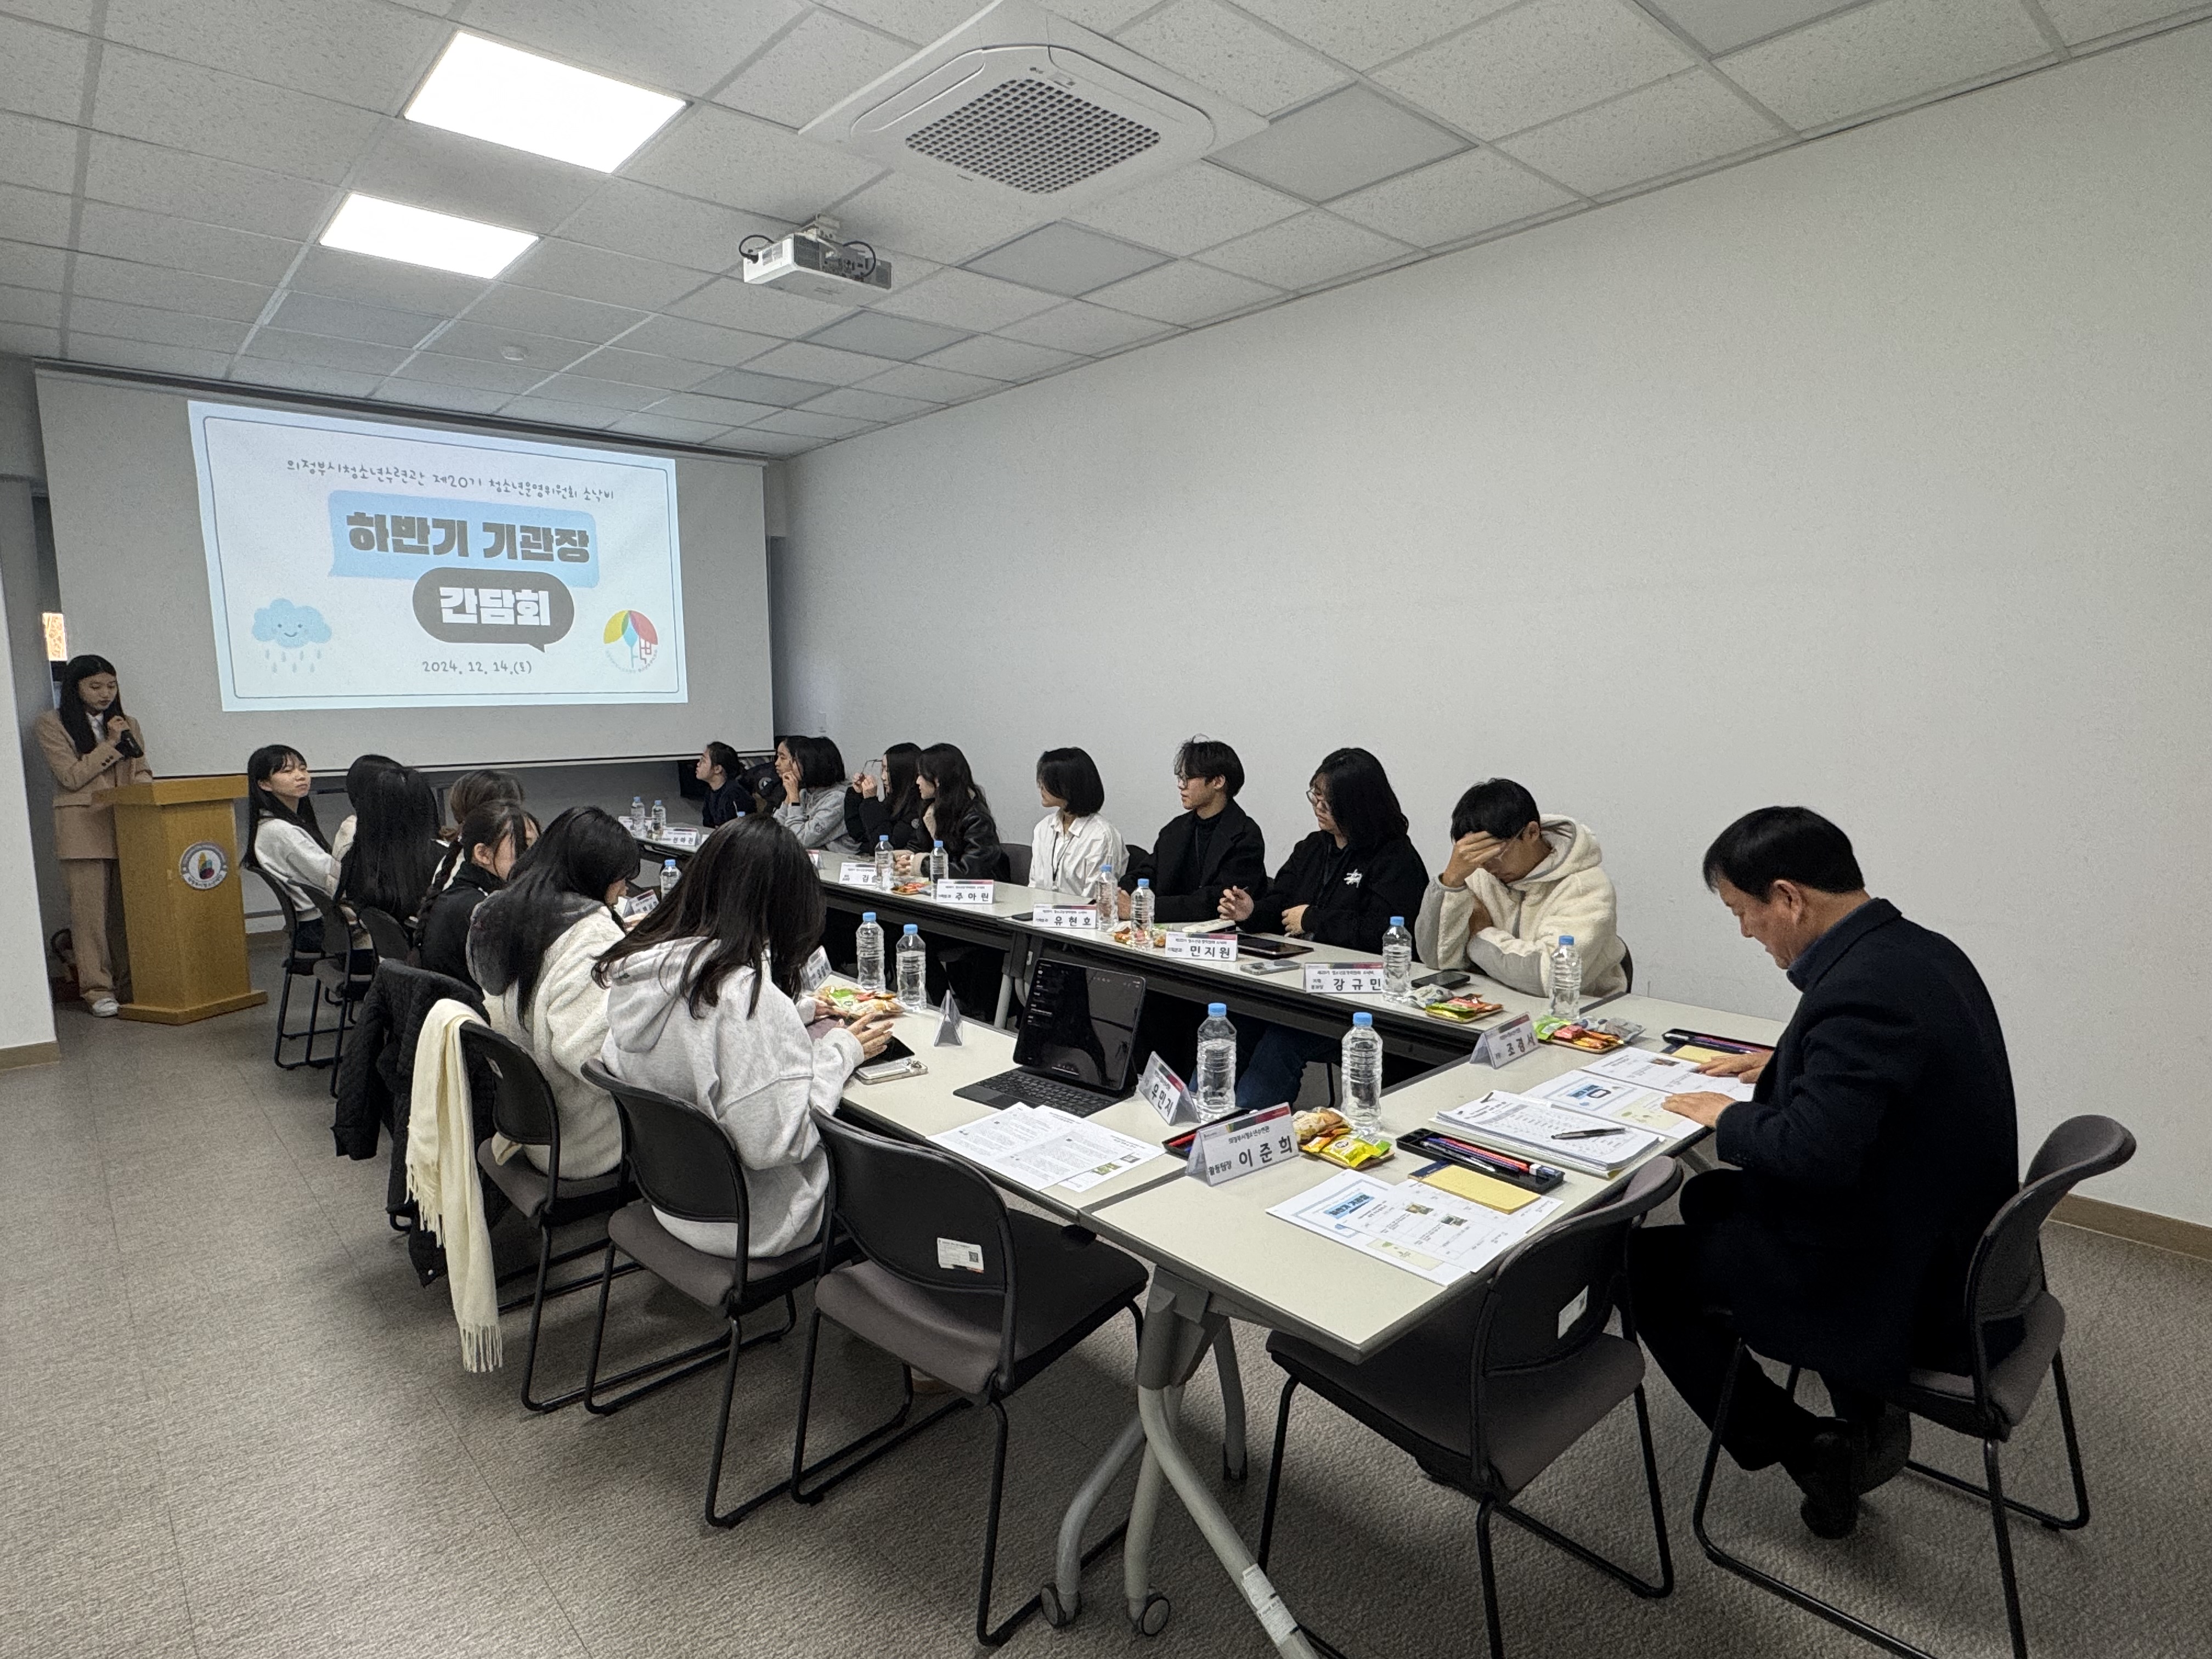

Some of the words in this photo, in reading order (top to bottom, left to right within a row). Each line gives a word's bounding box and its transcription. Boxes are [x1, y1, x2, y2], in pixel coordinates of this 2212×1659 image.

[287, 459, 425, 486] 의정부시청소년수련관
[432, 474, 482, 488] 제20기
[488, 478, 577, 499] 청소년운영위원회
[583, 487, 614, 503] 소낙비
[346, 511, 470, 558] 하반기
[482, 521, 590, 563] 기관장
[439, 586, 551, 626] 간담회
[422, 660, 463, 675] 2024.
[467, 661, 488, 675] 12.
